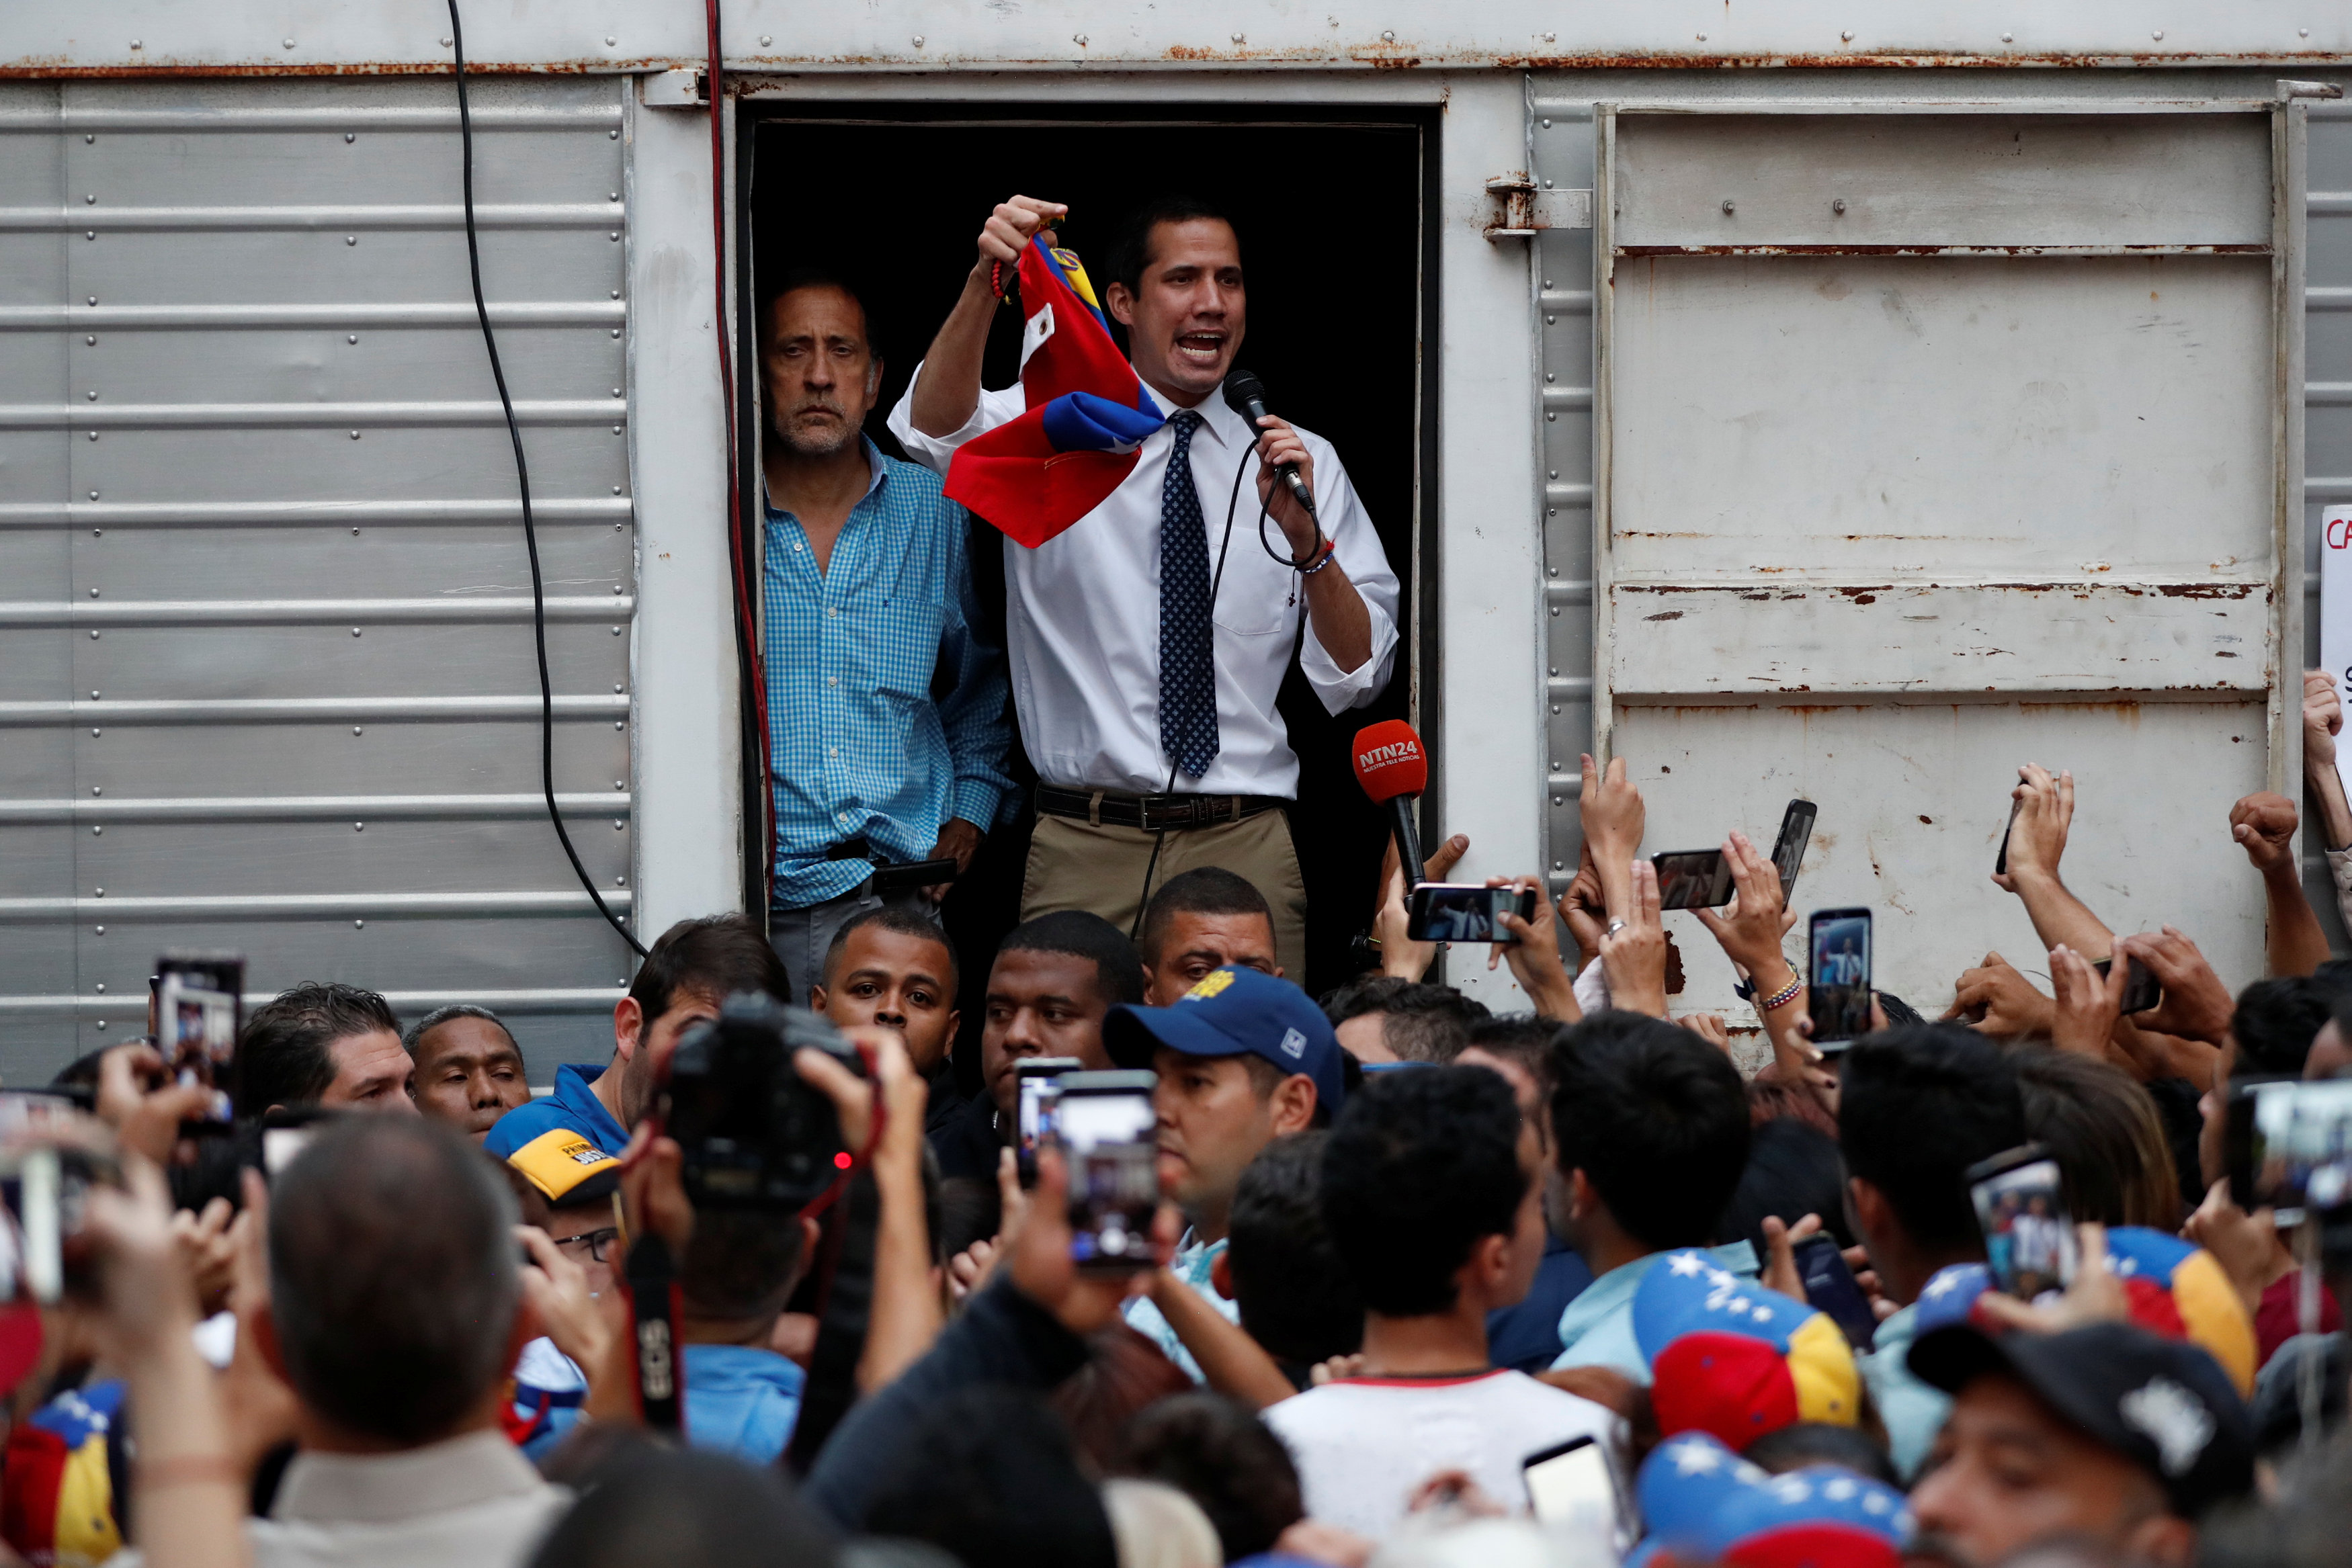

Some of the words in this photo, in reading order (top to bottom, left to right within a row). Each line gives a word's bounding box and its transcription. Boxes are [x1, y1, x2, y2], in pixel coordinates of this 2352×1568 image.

[1359, 740, 1418, 768] NTN24
[1363, 762, 1386, 773] NUESTRA
[1398, 754, 1420, 763] NOTICIAS
